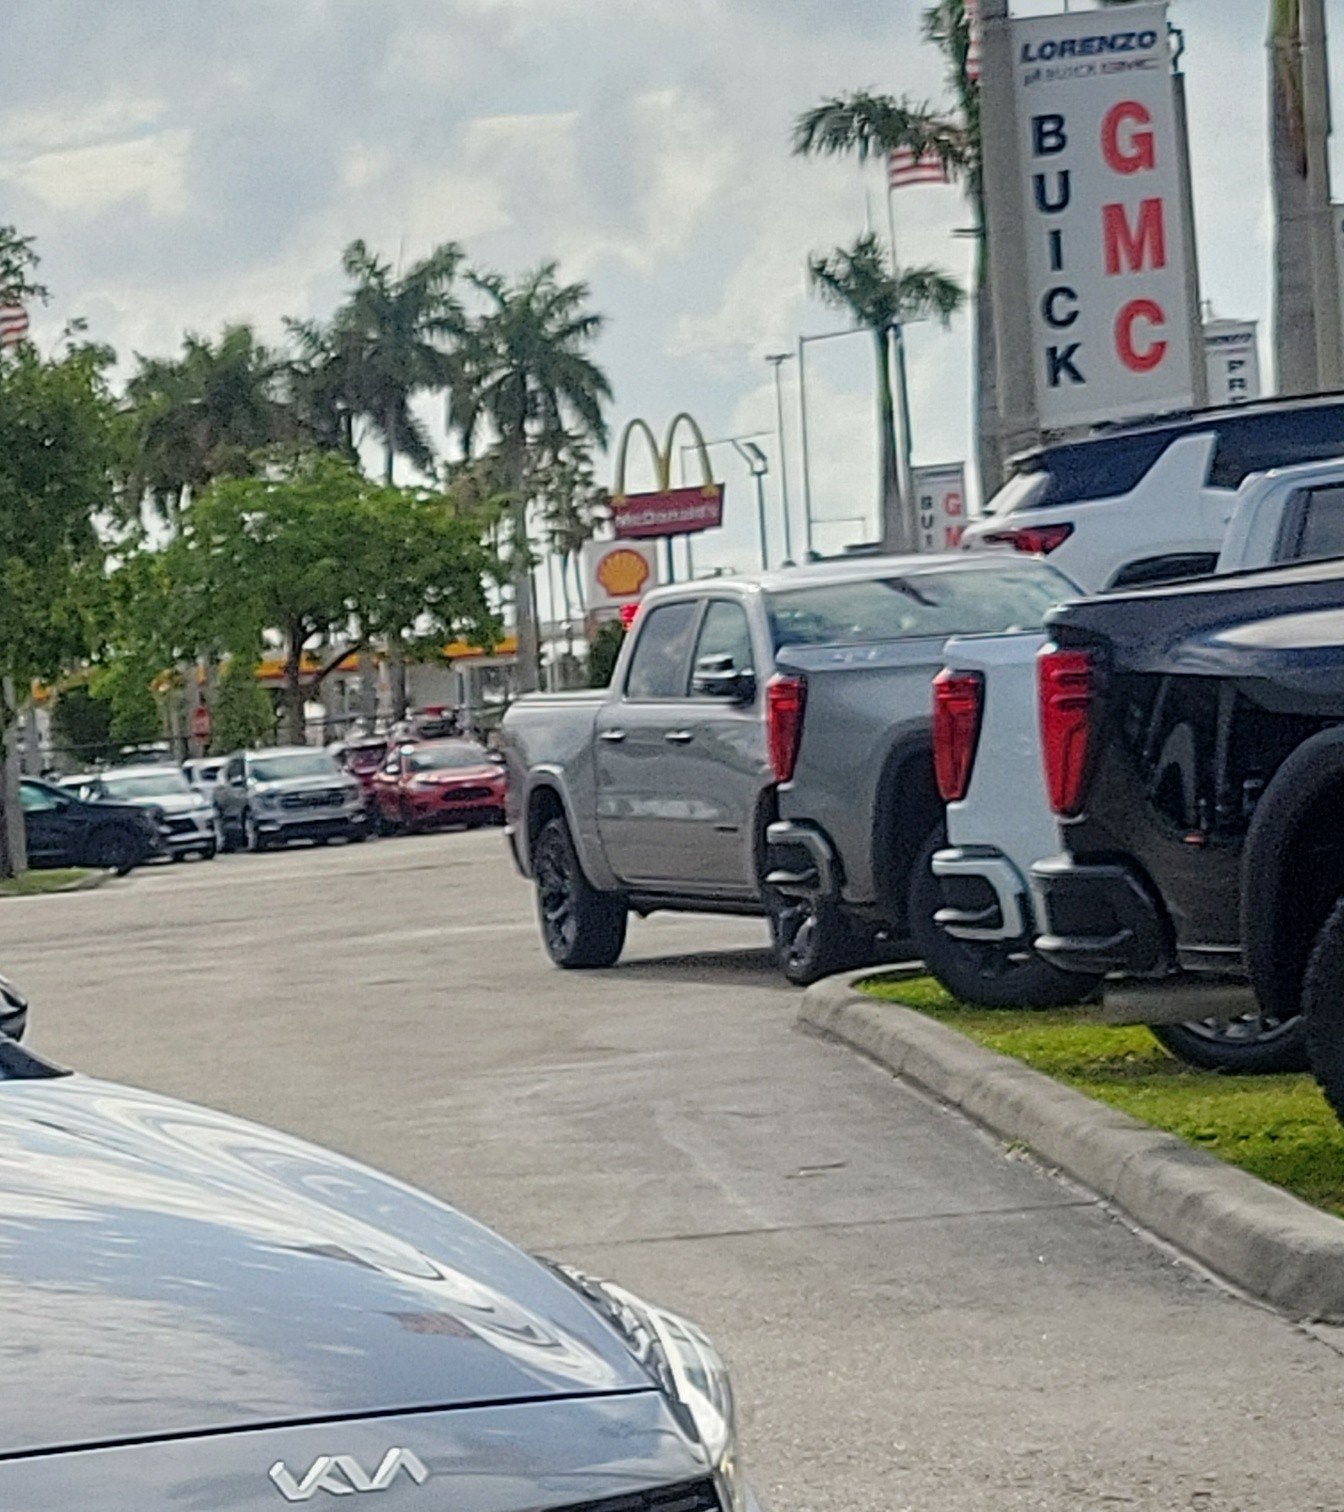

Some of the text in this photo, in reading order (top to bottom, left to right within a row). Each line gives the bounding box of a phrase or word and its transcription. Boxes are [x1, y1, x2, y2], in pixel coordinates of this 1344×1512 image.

[1020, 31, 1158, 63] LORENZO
[1030, 113, 1086, 389] BUICK
[1099, 100, 1168, 373] GMC
[269, 1446, 429, 1502] KIA
